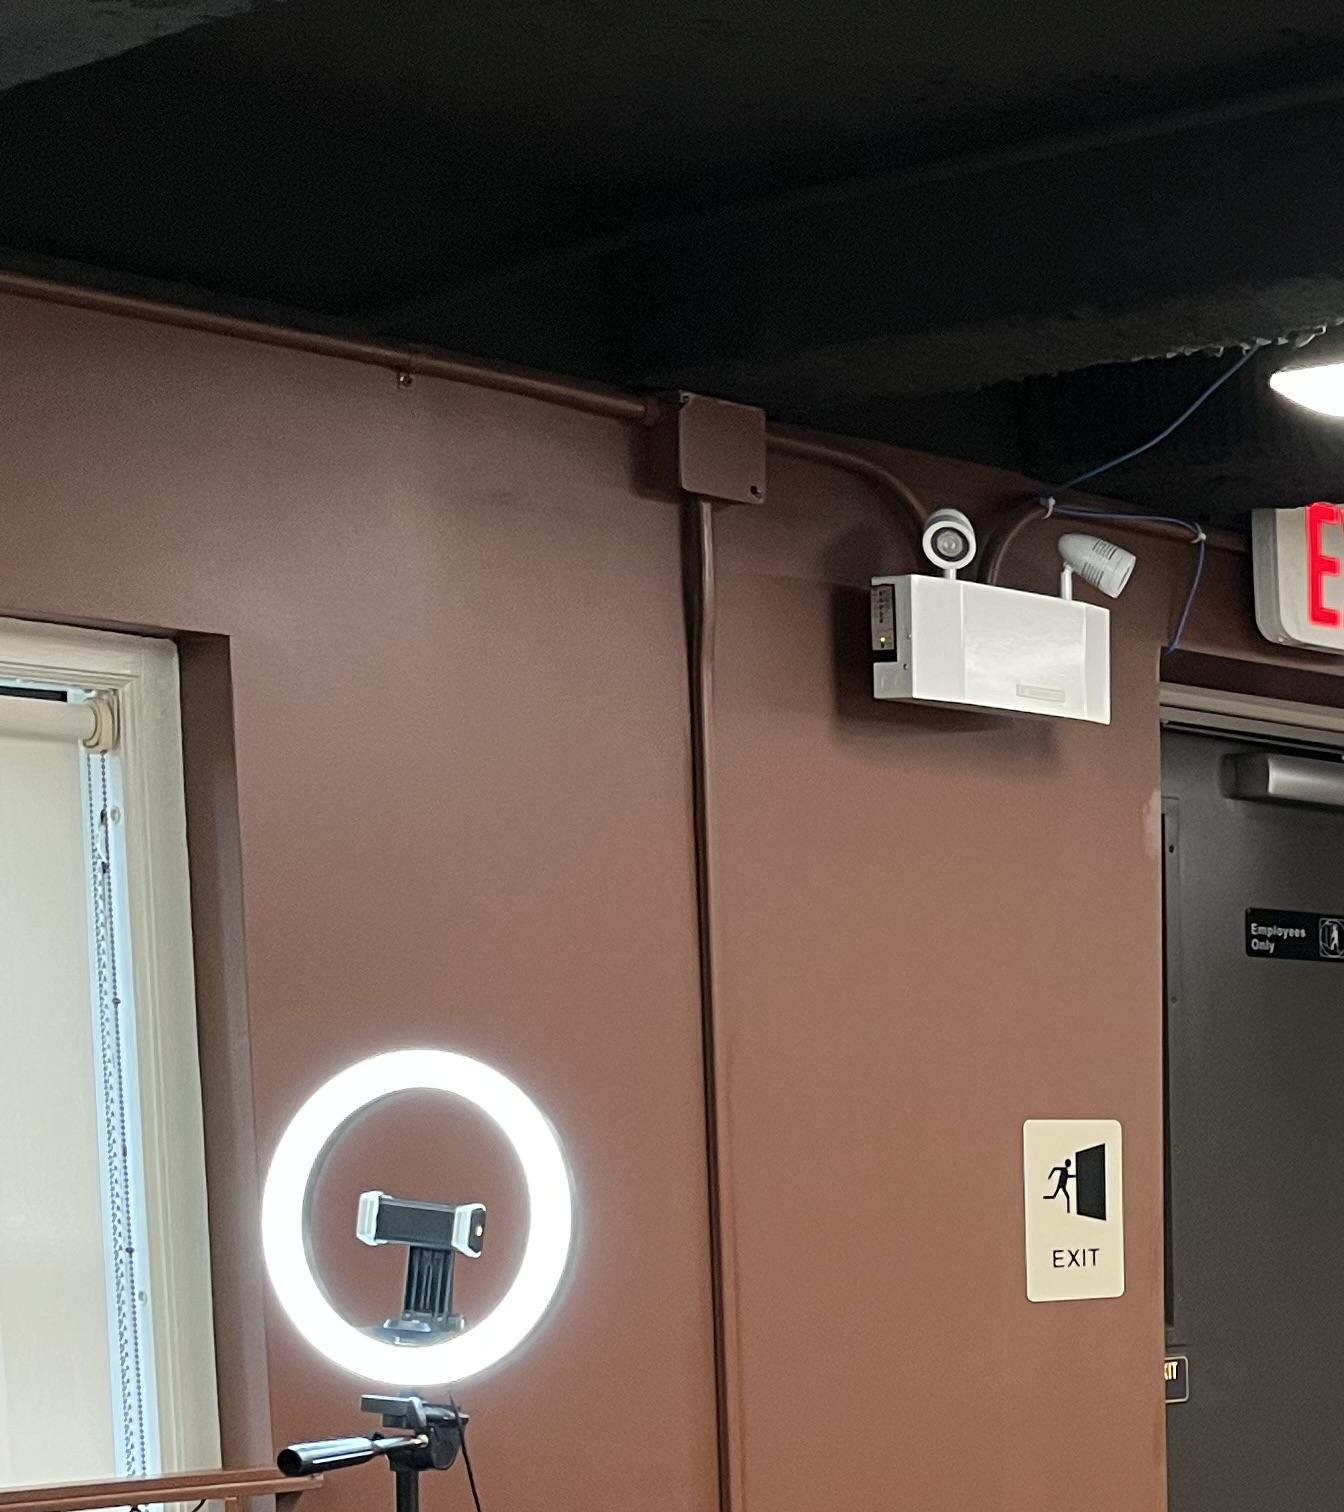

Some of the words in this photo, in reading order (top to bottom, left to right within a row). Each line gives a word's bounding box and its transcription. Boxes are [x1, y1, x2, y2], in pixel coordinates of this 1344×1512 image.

[1251, 923, 1306, 939] Employees
[1251, 938, 1275, 953] Only
[1053, 1248, 1100, 1268] EXIT
